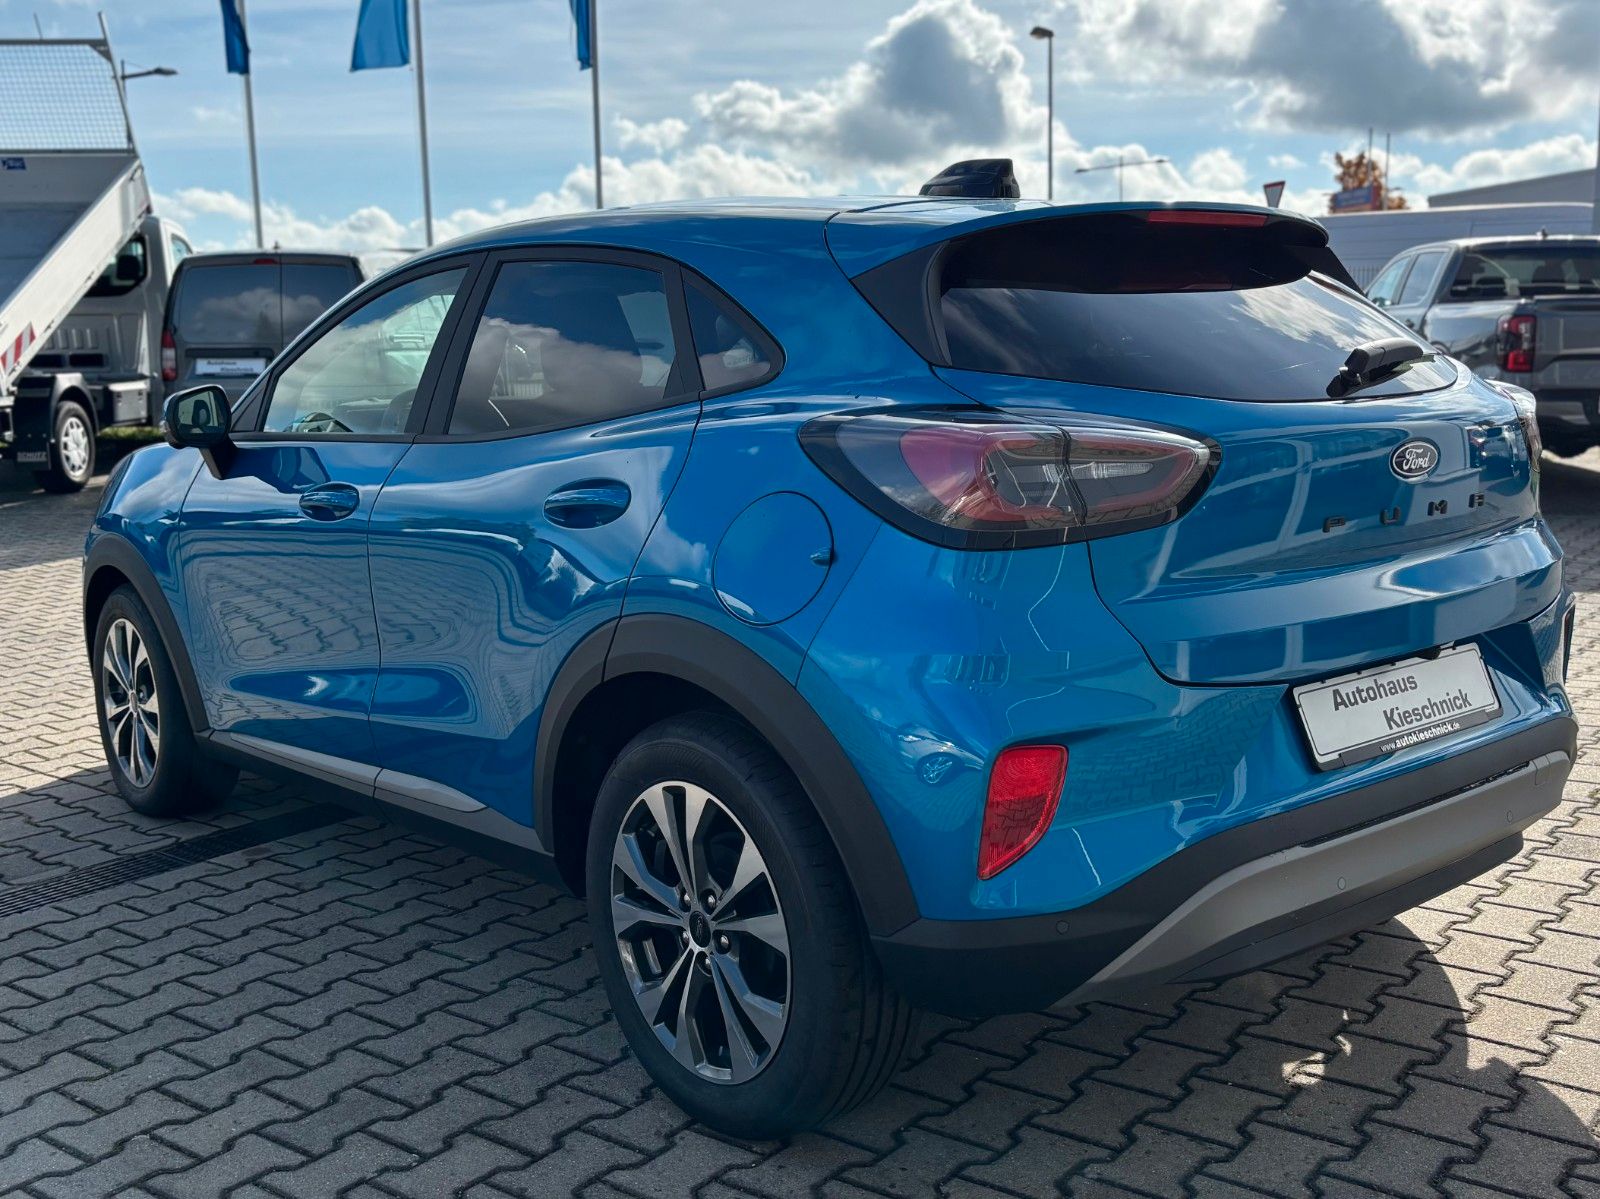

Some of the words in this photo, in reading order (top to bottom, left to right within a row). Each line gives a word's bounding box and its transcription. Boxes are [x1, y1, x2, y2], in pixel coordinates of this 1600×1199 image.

[1402, 448, 1430, 470] Ford
[1322, 492, 1485, 533] PUMA
[1332, 675, 1418, 711] Autohaus
[1383, 688, 1472, 730] Kieschnick
[1381, 721, 1461, 752] www.autokieschnick.de
